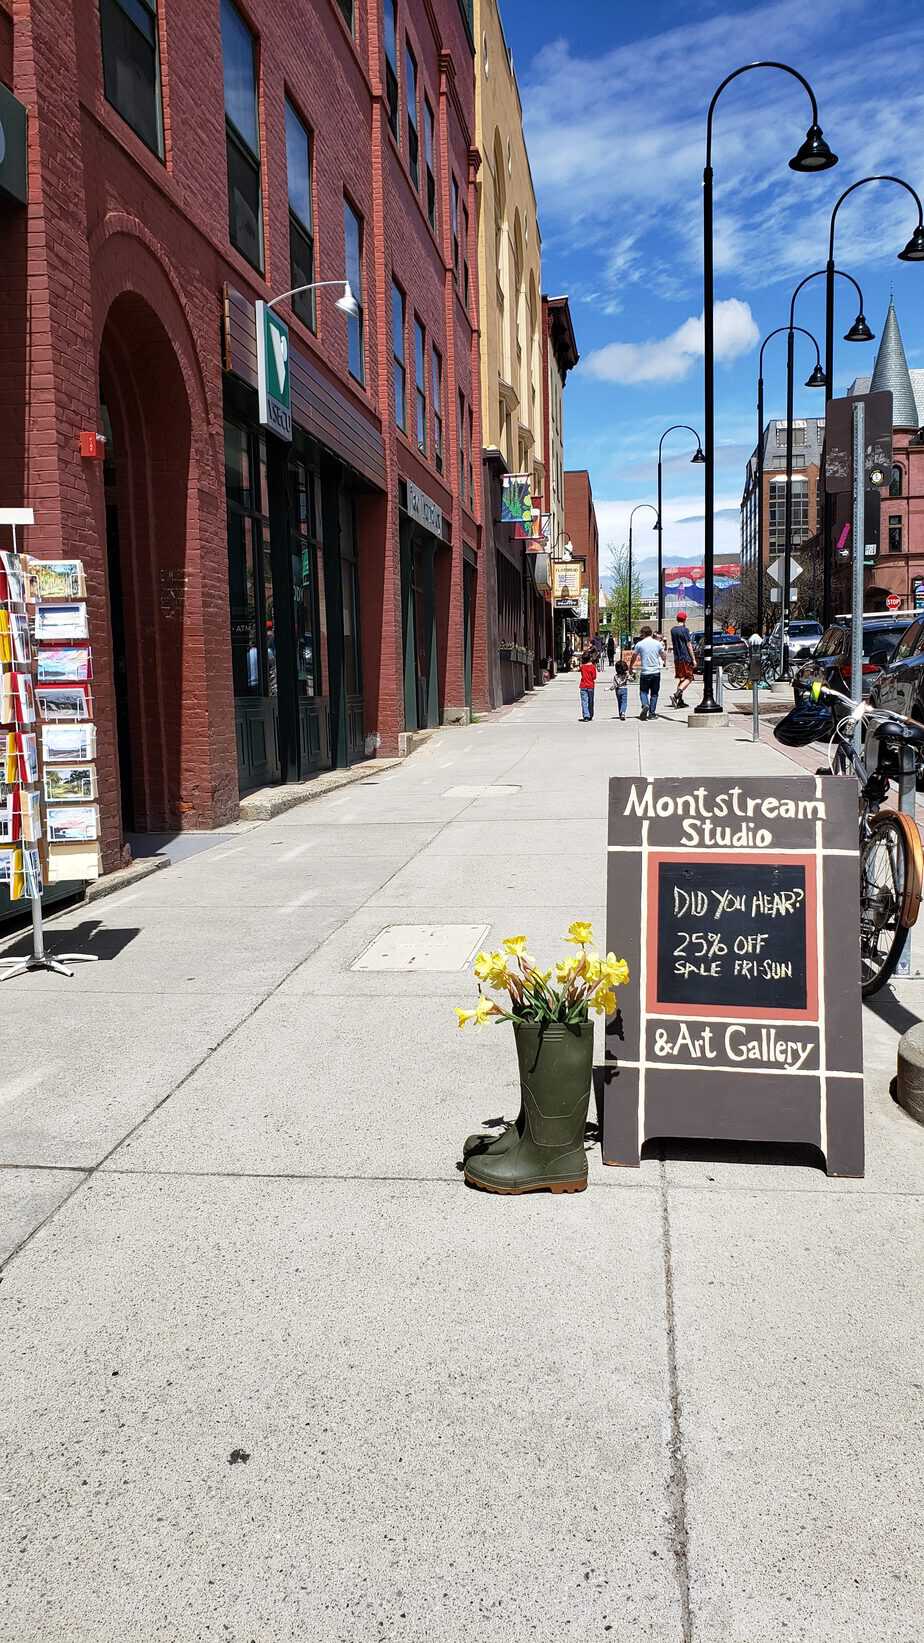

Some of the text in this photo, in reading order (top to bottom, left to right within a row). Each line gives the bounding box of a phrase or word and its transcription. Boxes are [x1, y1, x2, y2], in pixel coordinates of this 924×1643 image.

[887, 598, 899, 606] STOP
[623, 784, 826, 819] Montstream
[680, 819, 772, 847] Studio
[673, 885, 708, 919] DID
[752, 888, 804, 919] HEAR?
[673, 932, 769, 959] 25% OFF
[673, 960, 793, 980] SALE FRI-SUN
[654, 1023, 815, 1071] &Art Gallery
